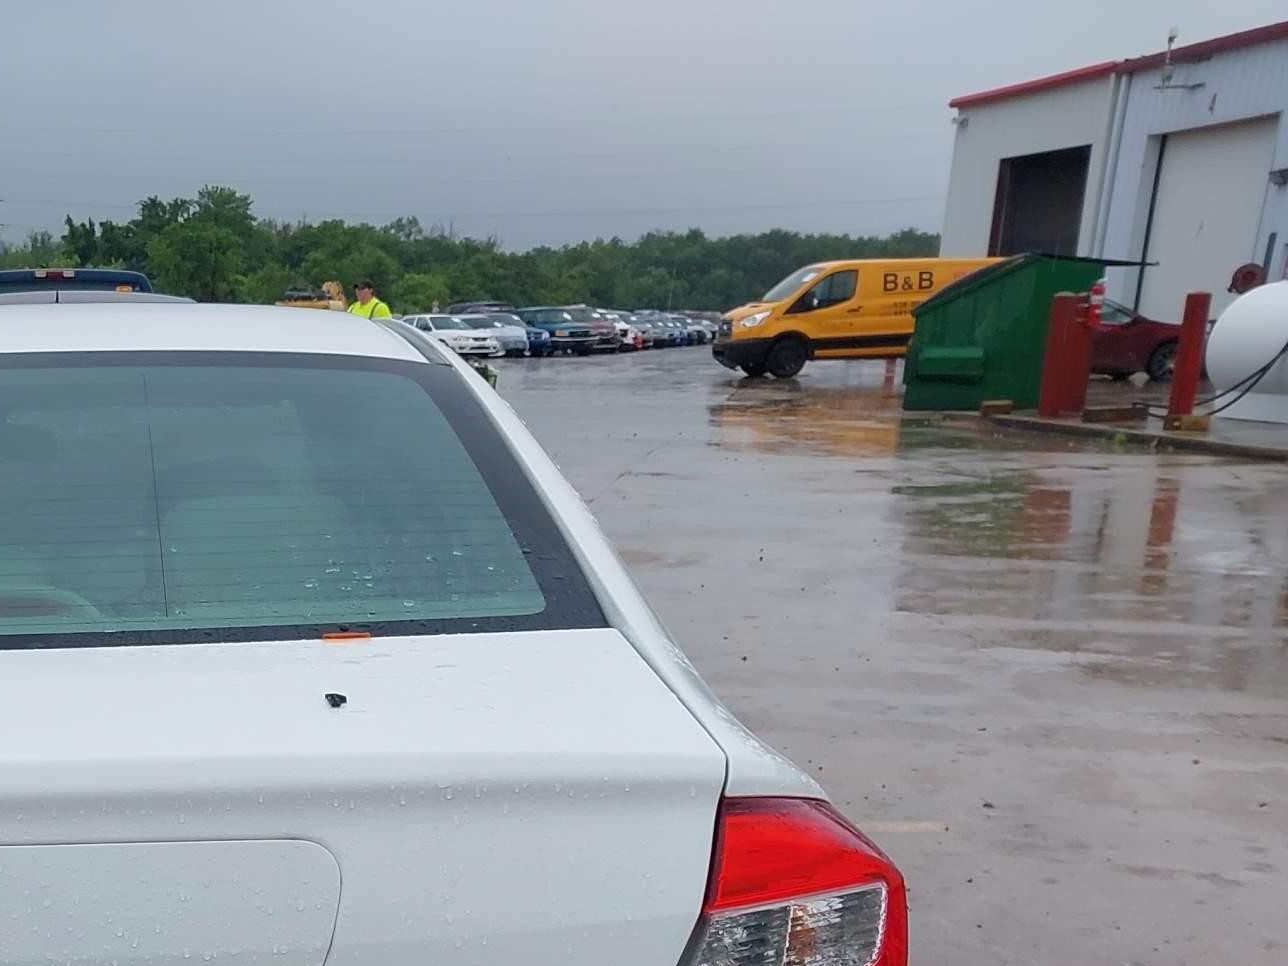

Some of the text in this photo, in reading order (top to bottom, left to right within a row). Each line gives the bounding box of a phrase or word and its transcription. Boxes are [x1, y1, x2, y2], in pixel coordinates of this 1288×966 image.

[883, 273, 898, 292] B
[902, 276, 913, 291] &
[918, 271, 934, 290] B
